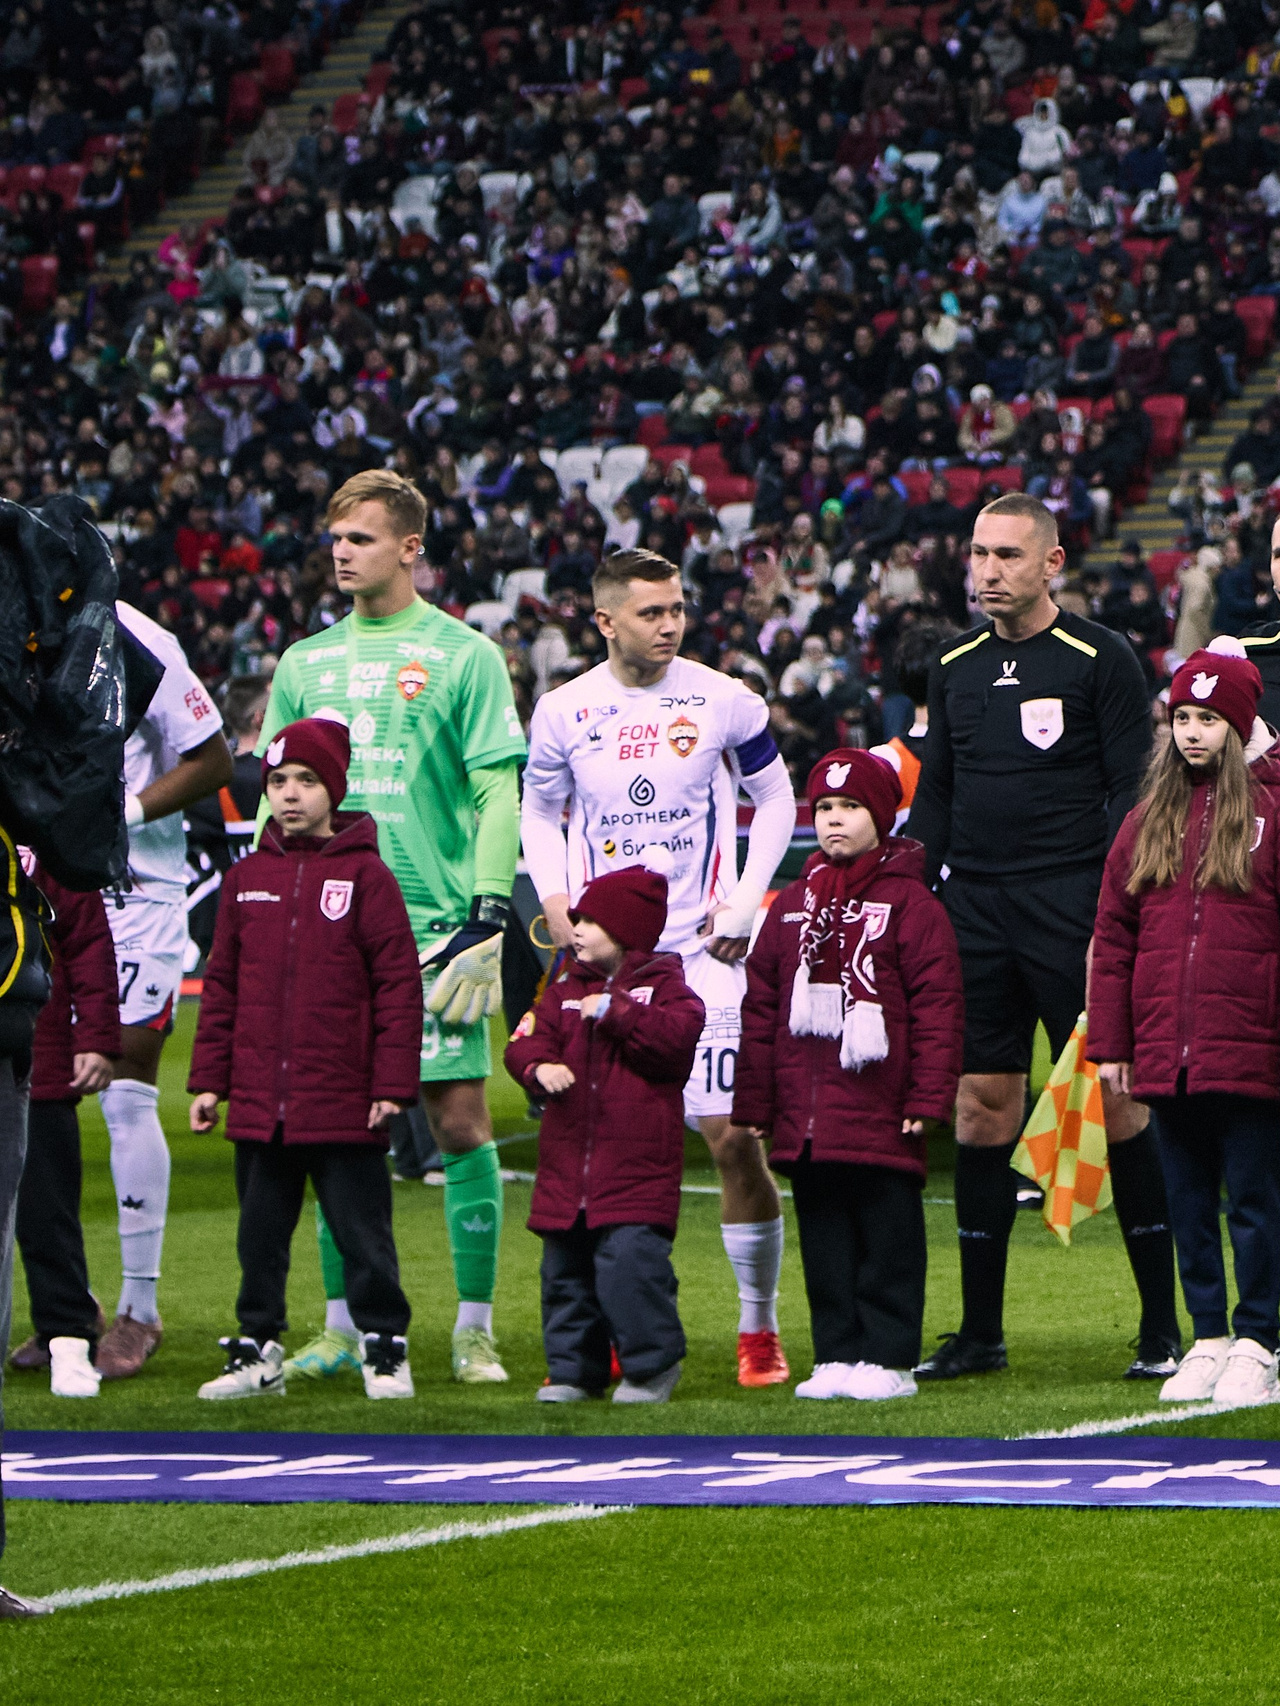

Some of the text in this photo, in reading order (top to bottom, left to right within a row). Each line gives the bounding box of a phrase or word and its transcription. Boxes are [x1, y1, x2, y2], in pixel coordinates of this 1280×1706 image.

[348, 661, 391, 681] FON
[184, 688, 203, 708] FO
[346, 680, 388, 699] BET
[618, 724, 659, 742] FON
[350, 747, 406, 762] THEKA
[619, 742, 660, 760] BET
[348, 776, 406, 796] илайн
[600, 807, 691, 827] APOTHEKA
[622, 836, 694, 857] биайн
[702, 1047, 738, 1093] 10
